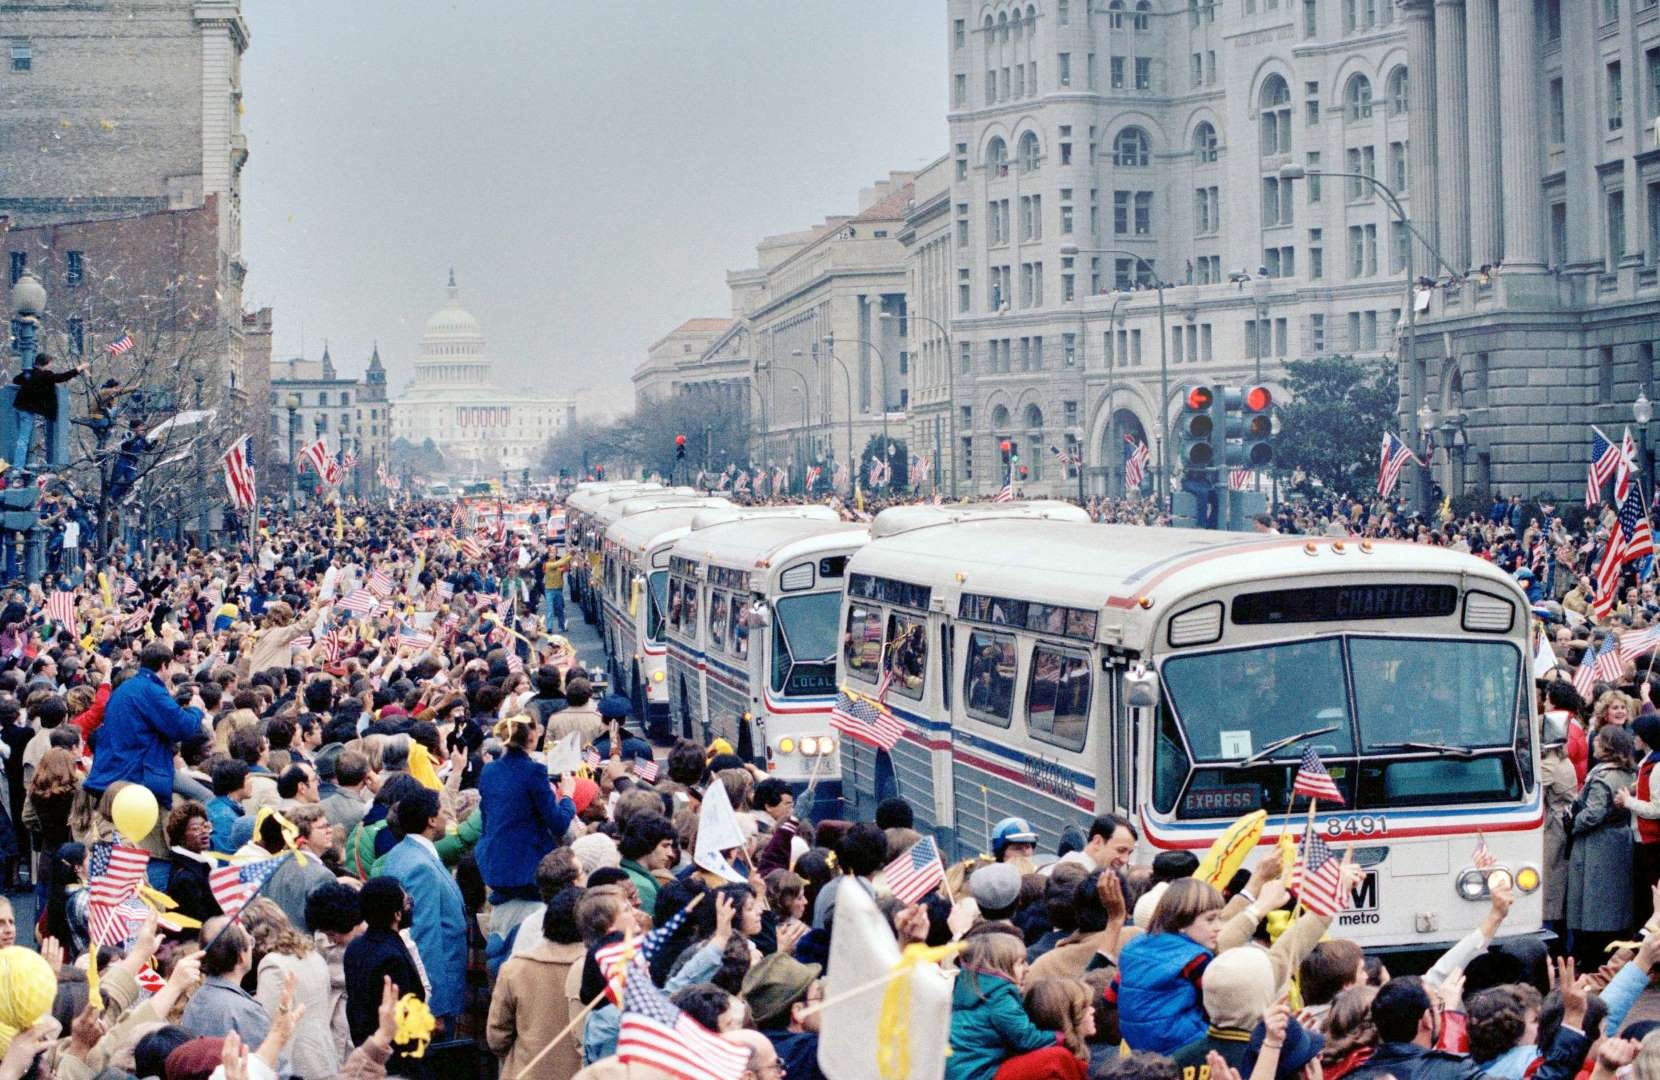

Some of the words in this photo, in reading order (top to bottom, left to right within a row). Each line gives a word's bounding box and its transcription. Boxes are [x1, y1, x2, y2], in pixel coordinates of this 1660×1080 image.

[1336, 587, 1450, 616] CHARTERED
[792, 677, 833, 688] LOCAL
[1186, 792, 1252, 809] EXPRESS
[1327, 816, 1388, 836] 8491
[1339, 912, 1380, 926] metro
